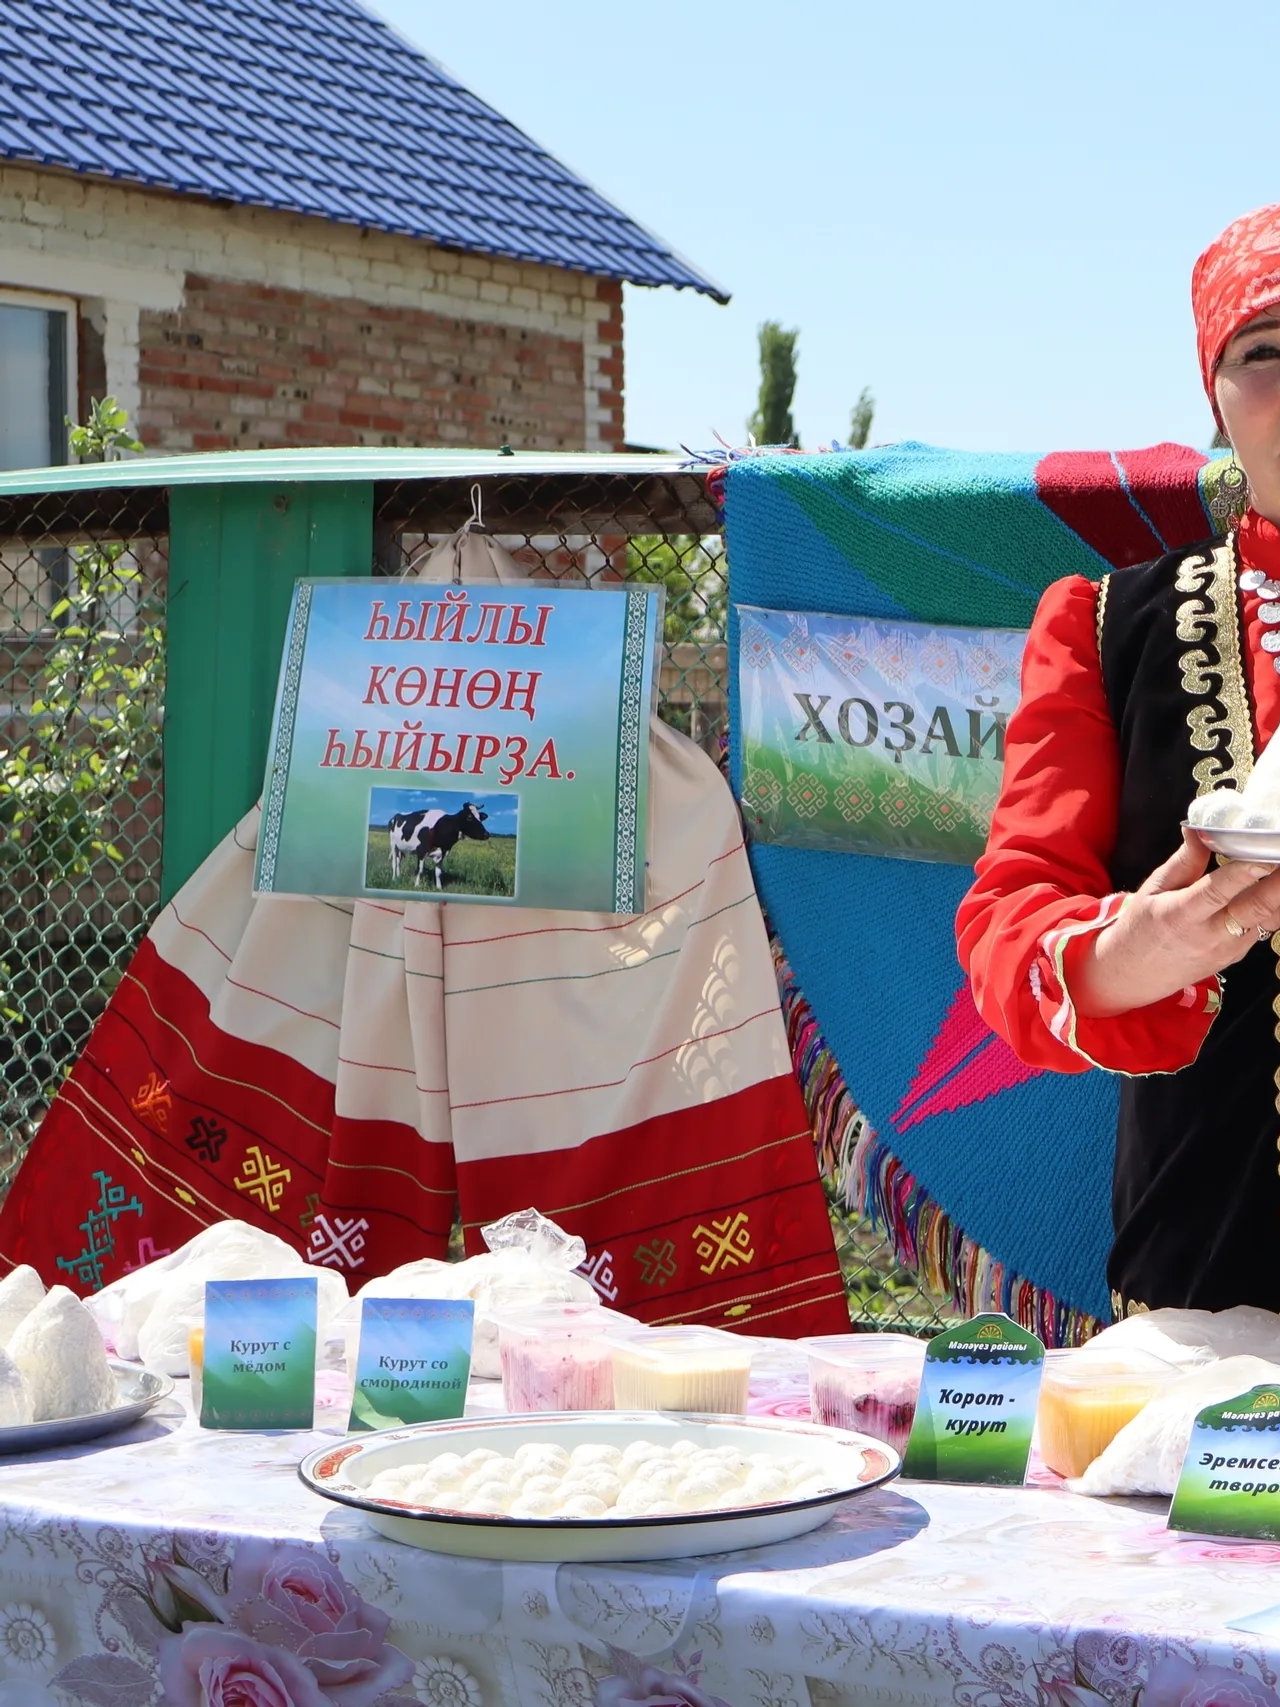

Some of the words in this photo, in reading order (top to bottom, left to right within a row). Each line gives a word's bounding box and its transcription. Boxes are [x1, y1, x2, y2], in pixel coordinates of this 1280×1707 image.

[362, 665, 543, 721] КӨНӨҢ
[230, 1340, 279, 1355] Курут
[283, 1341, 291, 1350] с
[989, 1341, 1028, 1352] районы
[233, 1360, 286, 1375] мёдом
[379, 1355, 427, 1371] Курут
[431, 1360, 448, 1370] со
[360, 1378, 462, 1391] смородиной
[945, 1419, 1008, 1436] курут
